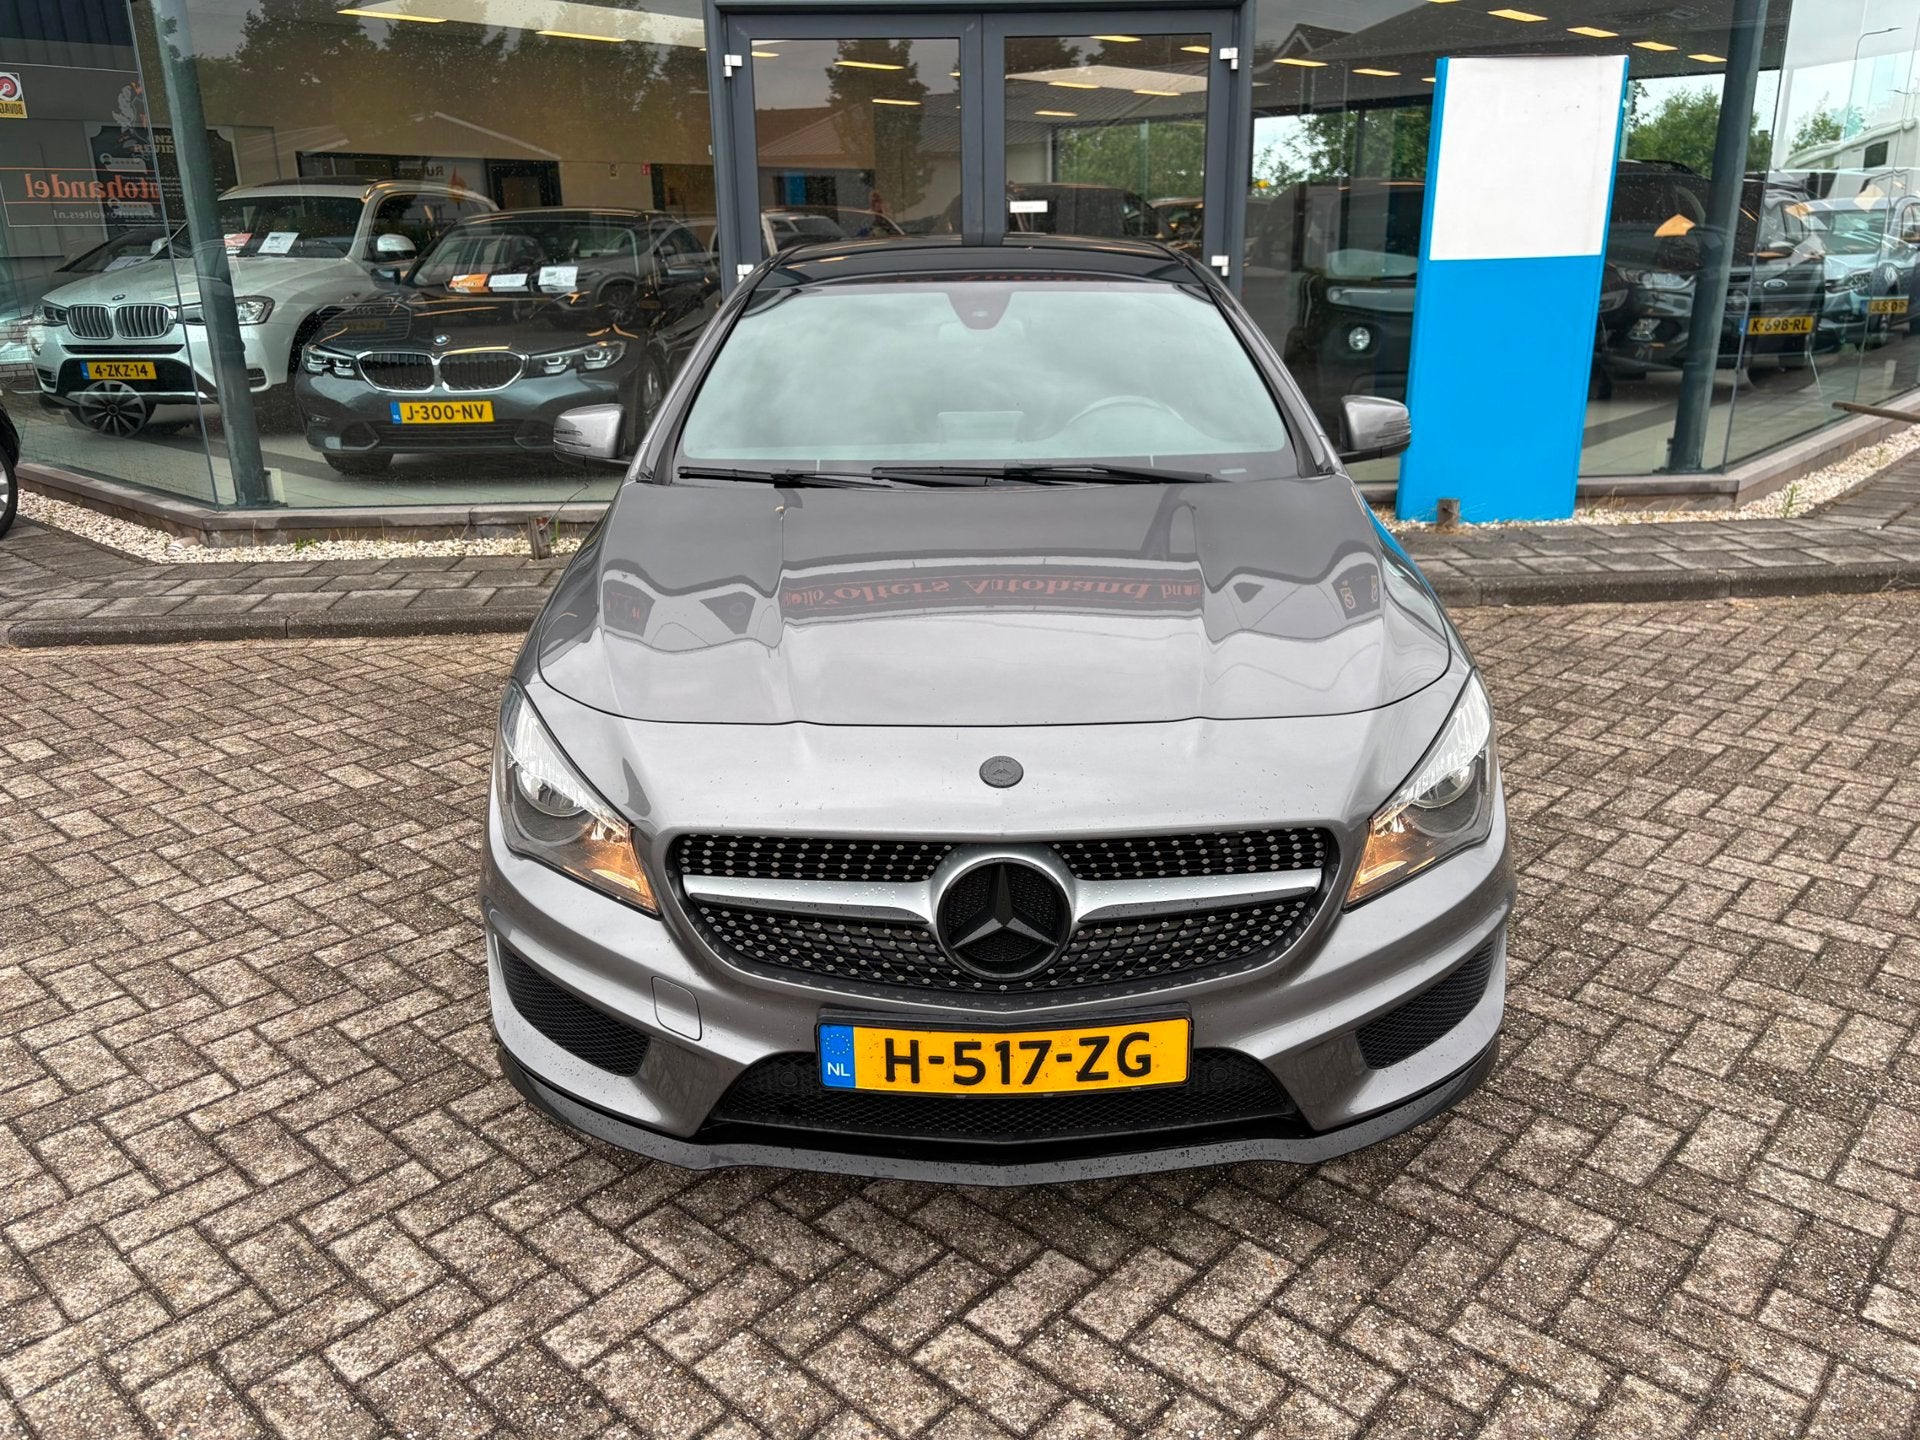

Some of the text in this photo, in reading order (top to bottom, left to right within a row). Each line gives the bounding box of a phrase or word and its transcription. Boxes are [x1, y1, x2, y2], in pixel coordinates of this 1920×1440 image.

[95, 364, 149, 378] 4-ZKZ-14
[406, 404, 485, 421] J-300-NV
[884, 1032, 1152, 1086] H-517-ZG
[827, 1061, 851, 1077] NL
